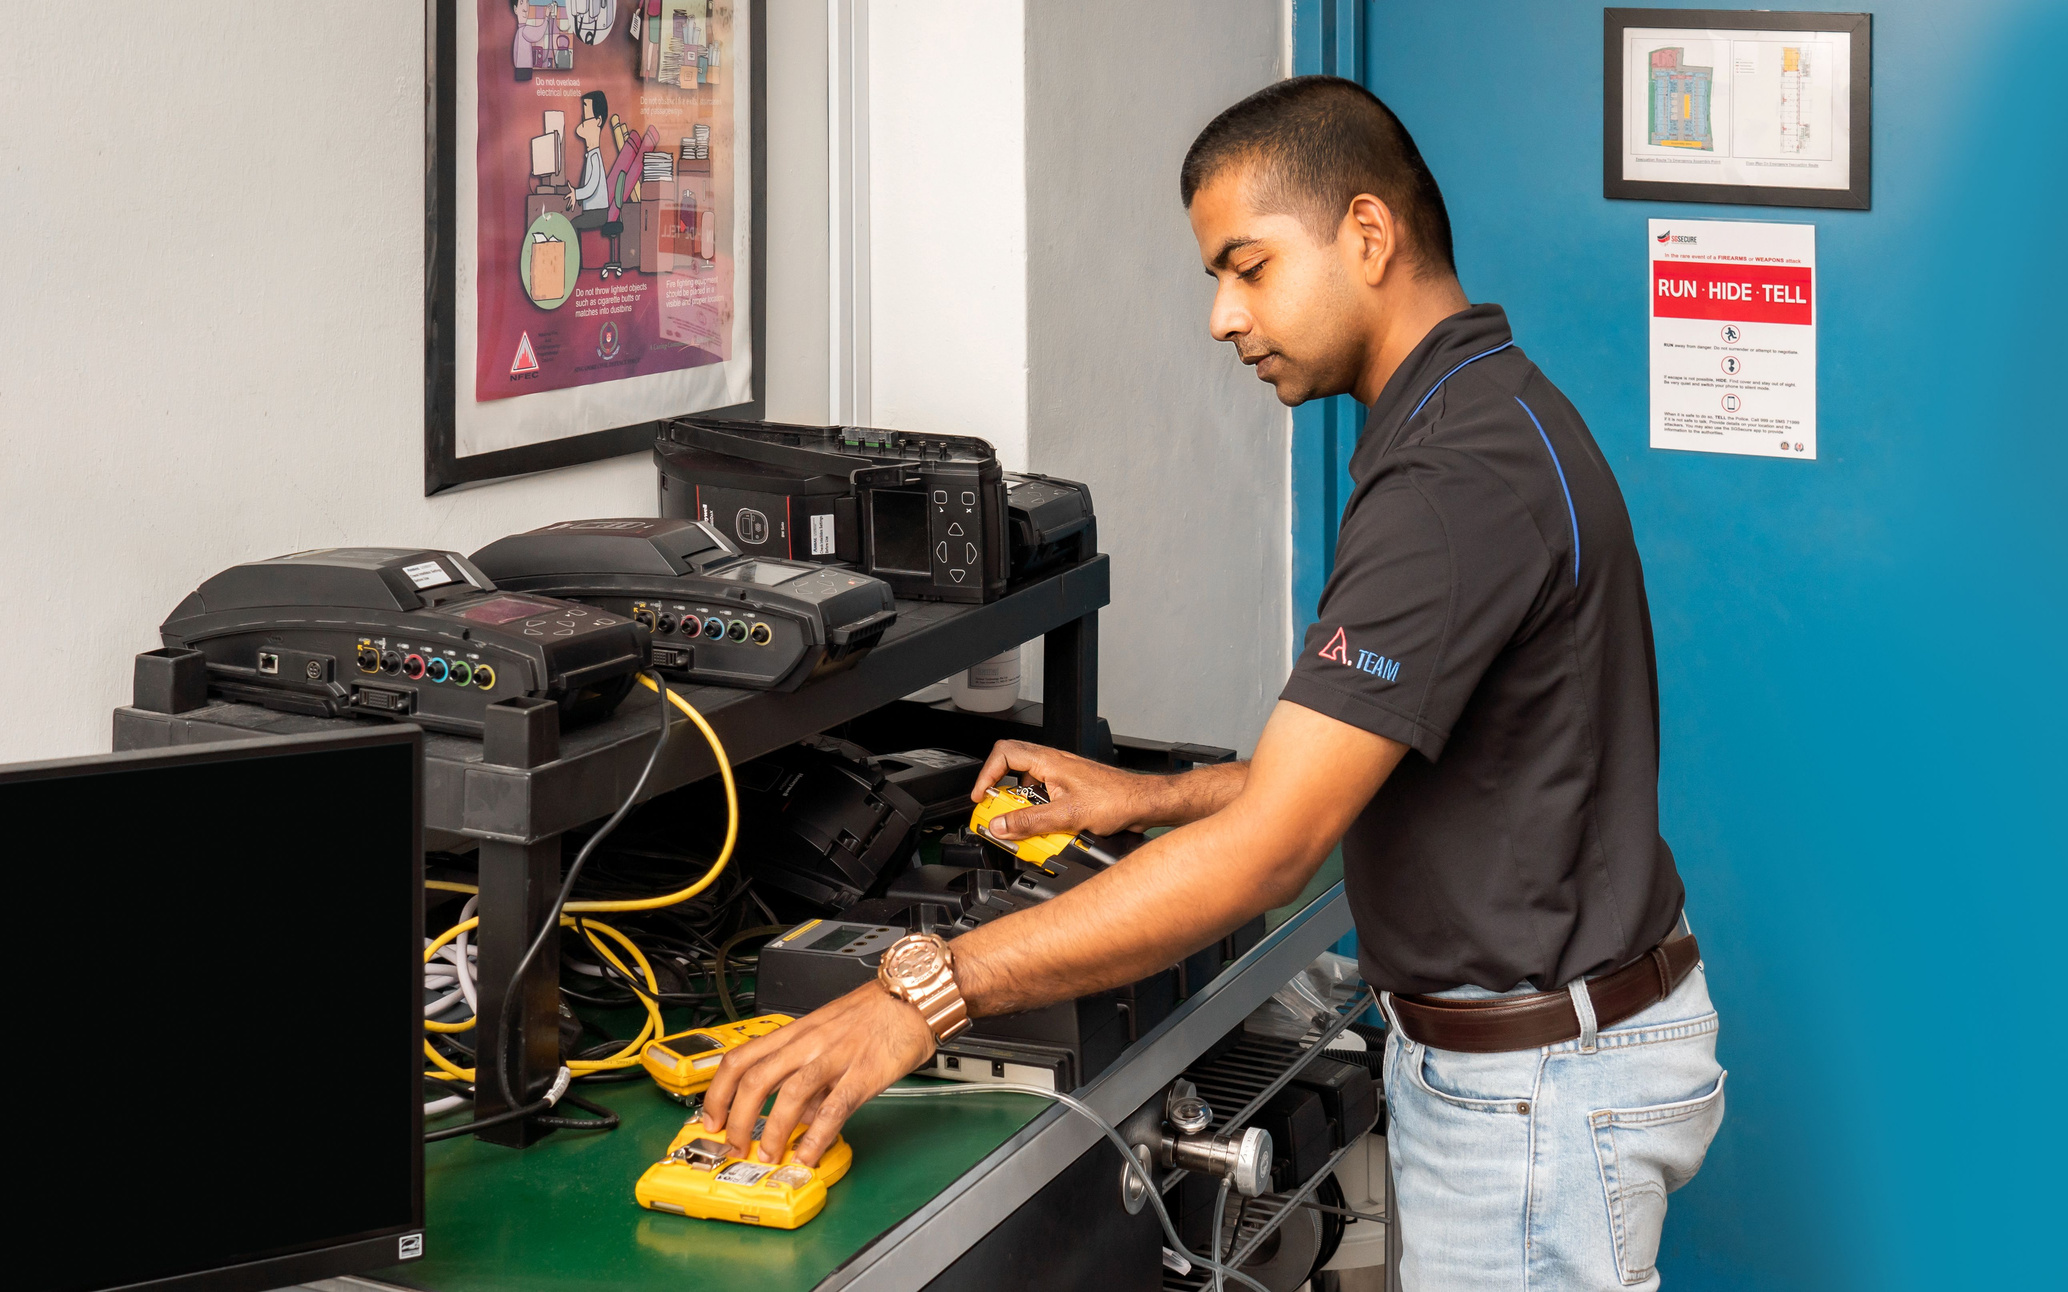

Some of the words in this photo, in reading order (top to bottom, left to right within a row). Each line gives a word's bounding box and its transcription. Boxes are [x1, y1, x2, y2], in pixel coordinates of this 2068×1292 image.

[536, 77, 544, 86] Do
[536, 88, 562, 96] electrical
[563, 88, 581, 97] outlets
[666, 279, 676, 288] Fire
[677, 279, 693, 289] fighting
[695, 276, 718, 286] equipment
[576, 288, 584, 297] Do
[595, 287, 610, 295] throw
[611, 285, 628, 295] lighted
[629, 283, 647, 293] objects
[666, 289, 682, 298] should
[690, 287, 705, 296] placed
[1658, 279, 1697, 298] RUN
[1709, 281, 1752, 301] HIDE
[1762, 284, 1807, 304] TELL
[598, 296, 620, 306] cigarette
[666, 299, 681, 308] visible
[692, 297, 707, 306] proper
[708, 295, 724, 303] location
[575, 308, 598, 318] matches
[610, 304, 632, 314] dustbins
[510, 371, 539, 382] NFEC
[1356, 649, 1401, 682] TEAM
